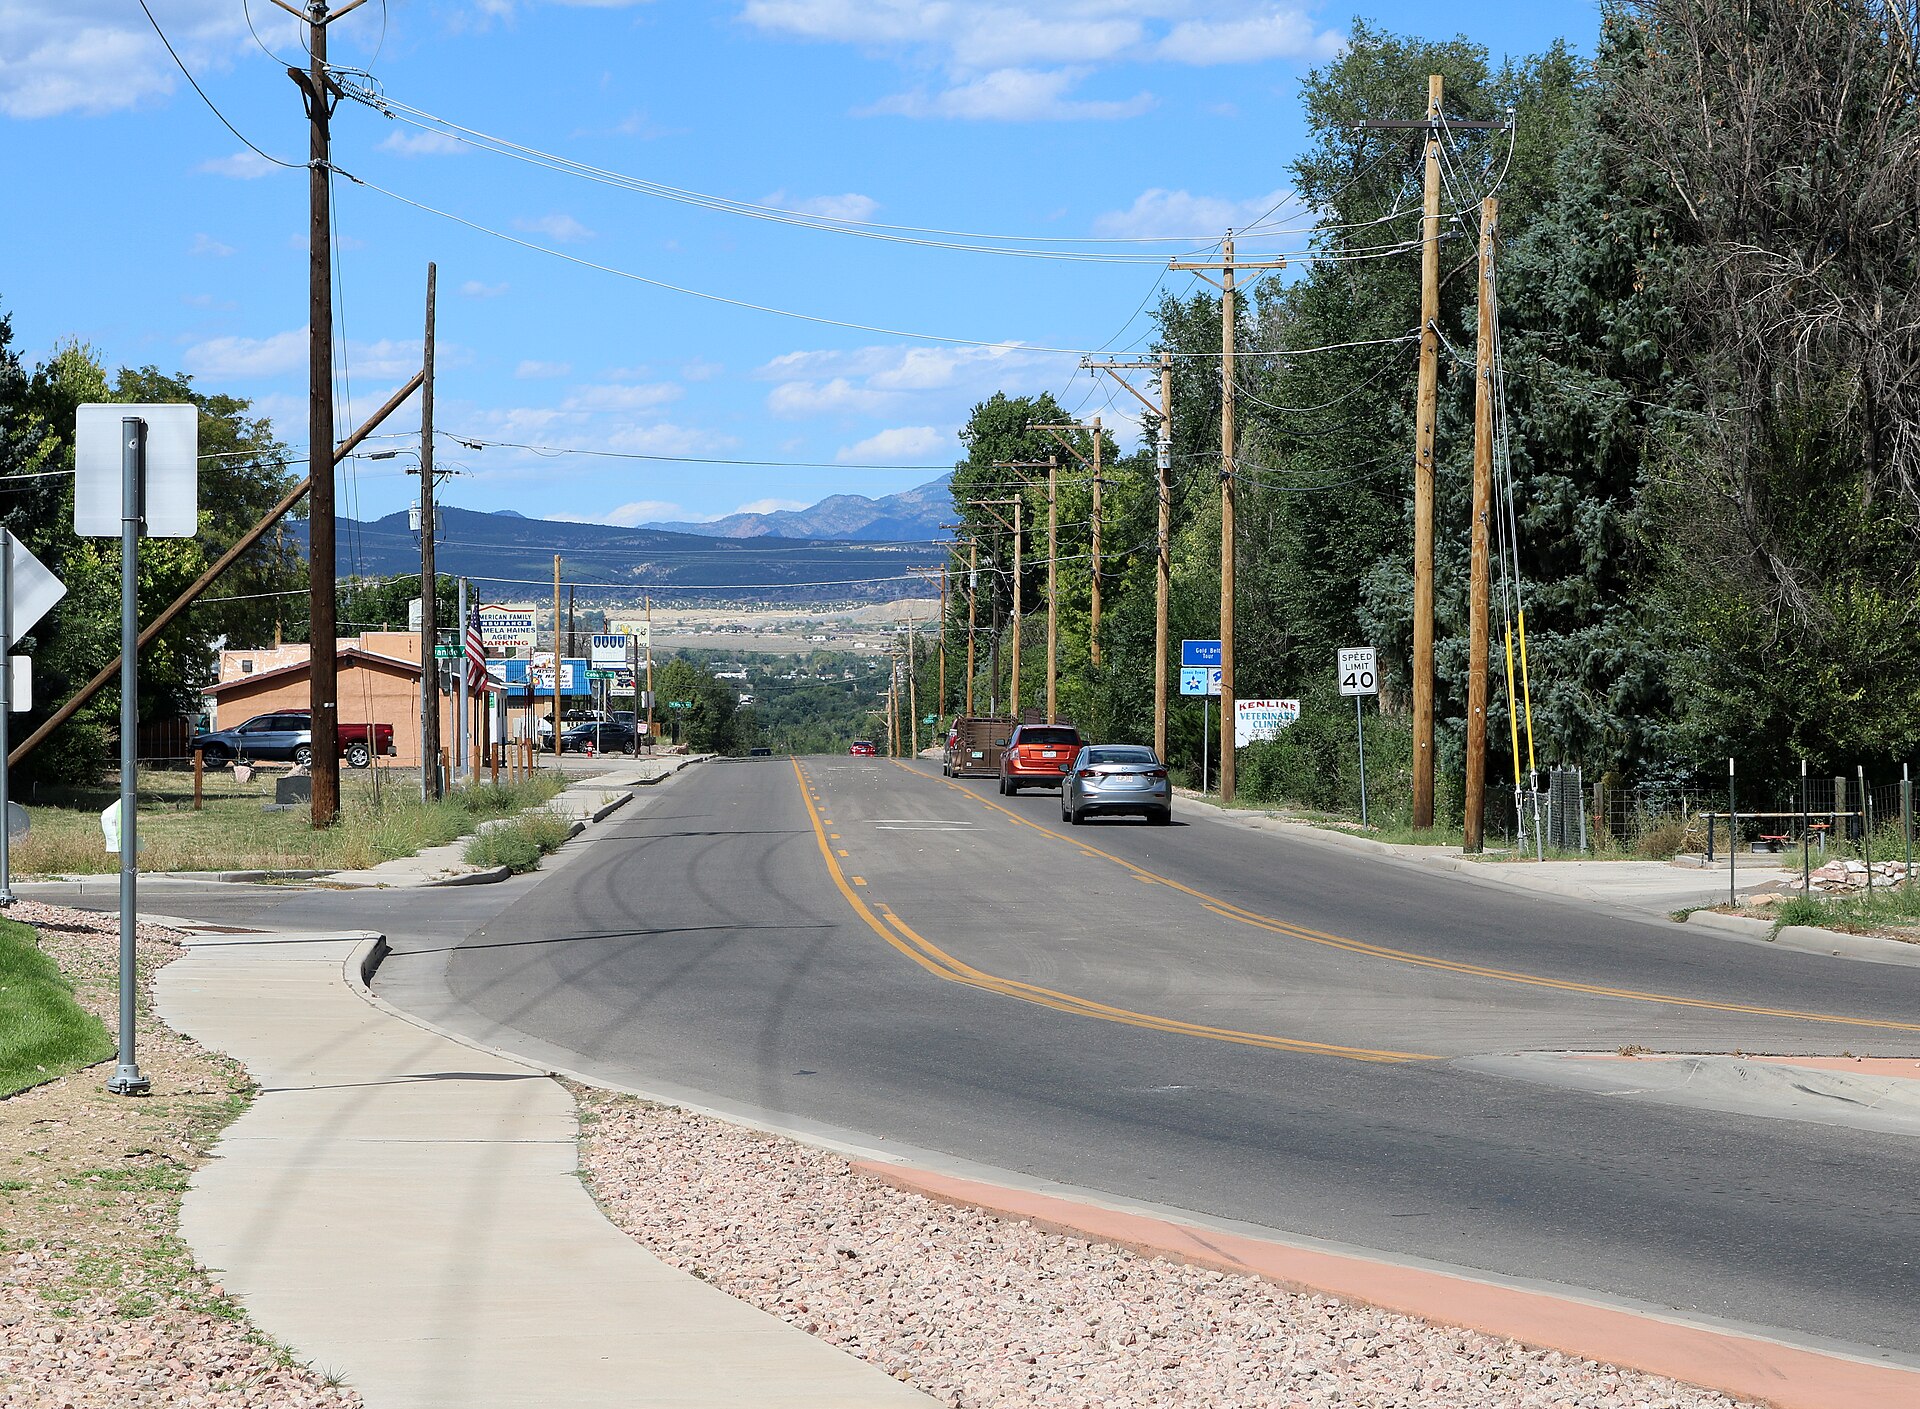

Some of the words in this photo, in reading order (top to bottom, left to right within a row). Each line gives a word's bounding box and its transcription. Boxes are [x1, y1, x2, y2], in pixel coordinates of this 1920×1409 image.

[1342, 653, 1372, 661] SPEED
[1345, 663, 1369, 671] LIMIT
[1342, 671, 1374, 689] 40
[1239, 700, 1296, 711] KENLINE
[1240, 712, 1296, 721] VETERINARY
[1252, 720, 1282, 729] CLINIC
